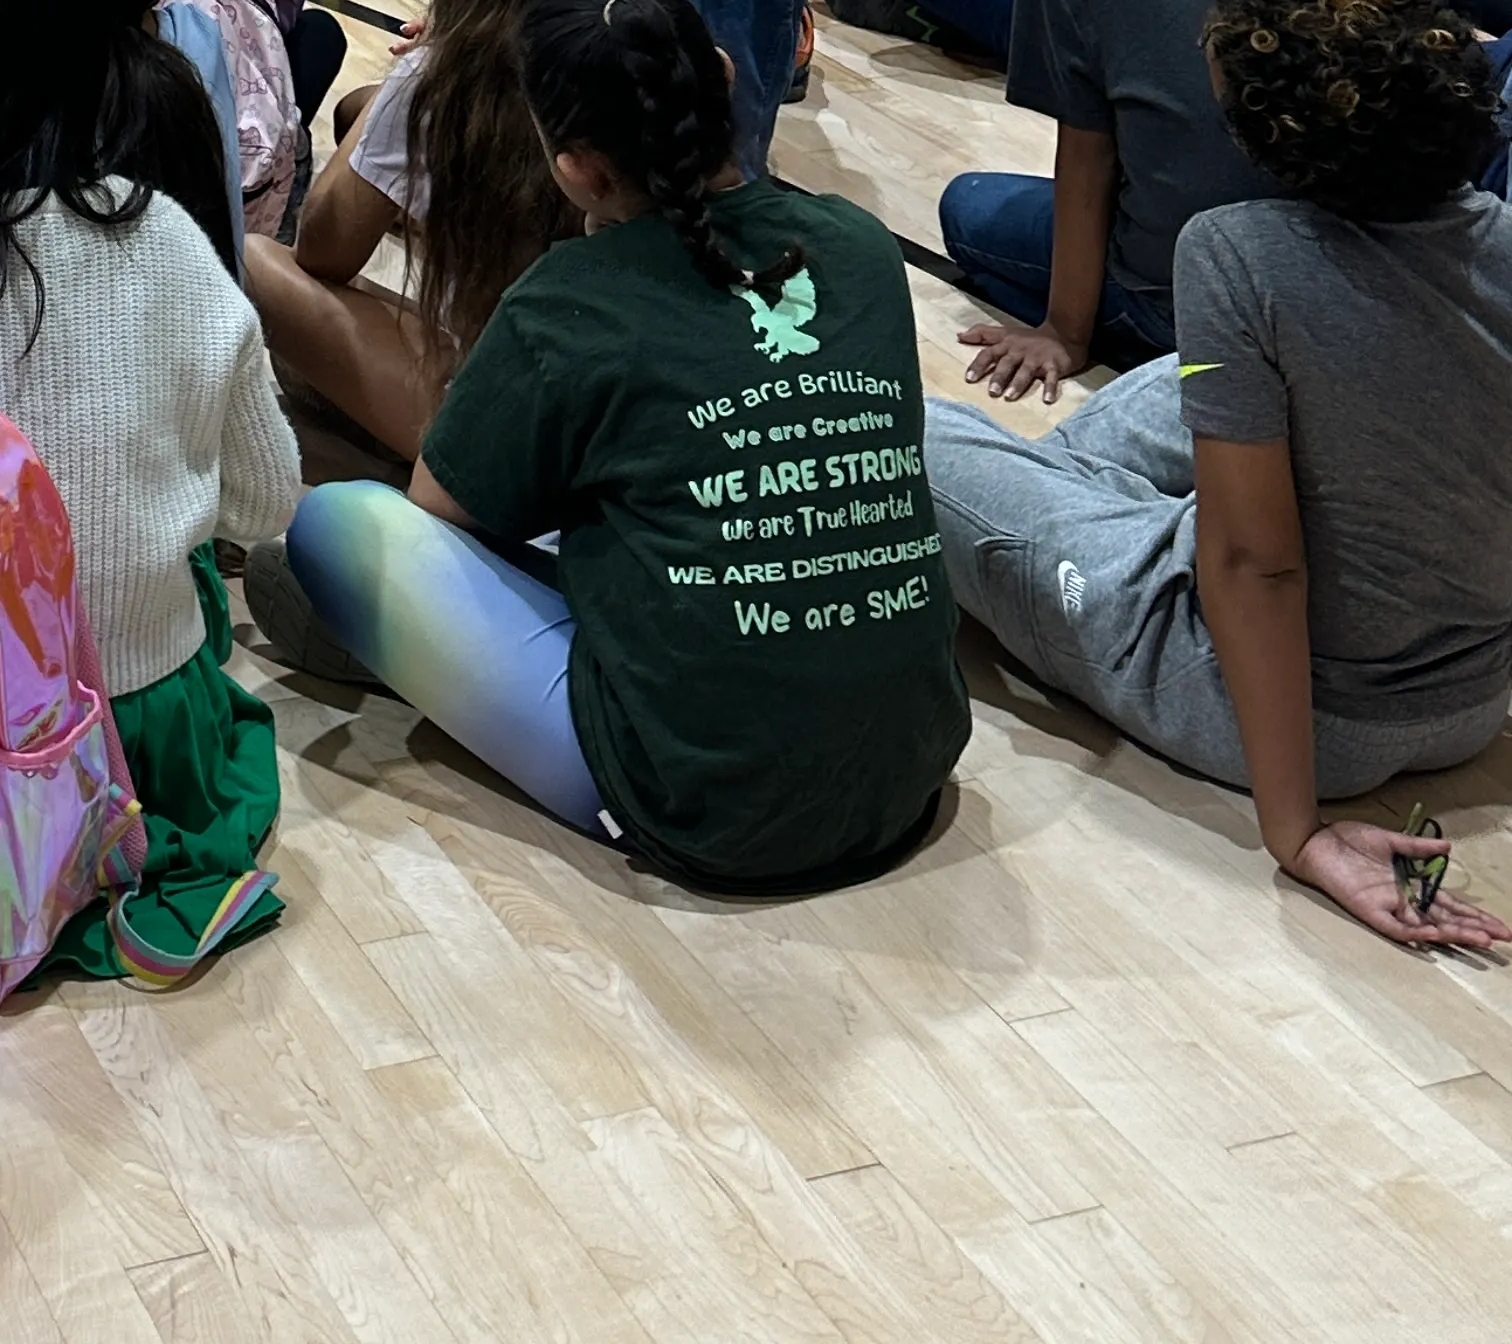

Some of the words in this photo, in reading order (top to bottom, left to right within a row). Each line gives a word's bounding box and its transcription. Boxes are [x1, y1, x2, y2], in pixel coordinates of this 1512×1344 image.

[687, 397, 736, 429] We
[741, 379, 792, 408] are
[797, 370, 903, 401] Brilliant
[721, 428, 761, 450] We
[768, 422, 807, 442] are
[812, 411, 893, 437] Creative
[688, 469, 748, 509] WE
[758, 458, 819, 497] ARE
[825, 444, 922, 488] STRONG
[758, 515, 795, 539] are
[796, 505, 848, 538] True
[849, 489, 914, 527] Hearted
[667, 565, 716, 585] WE
[722, 562, 786, 585] ARE
[1064, 571, 1086, 614] NIKE
[733, 600, 791, 636] We
[805, 603, 856, 632] are
[866, 575, 930, 621] SME!
